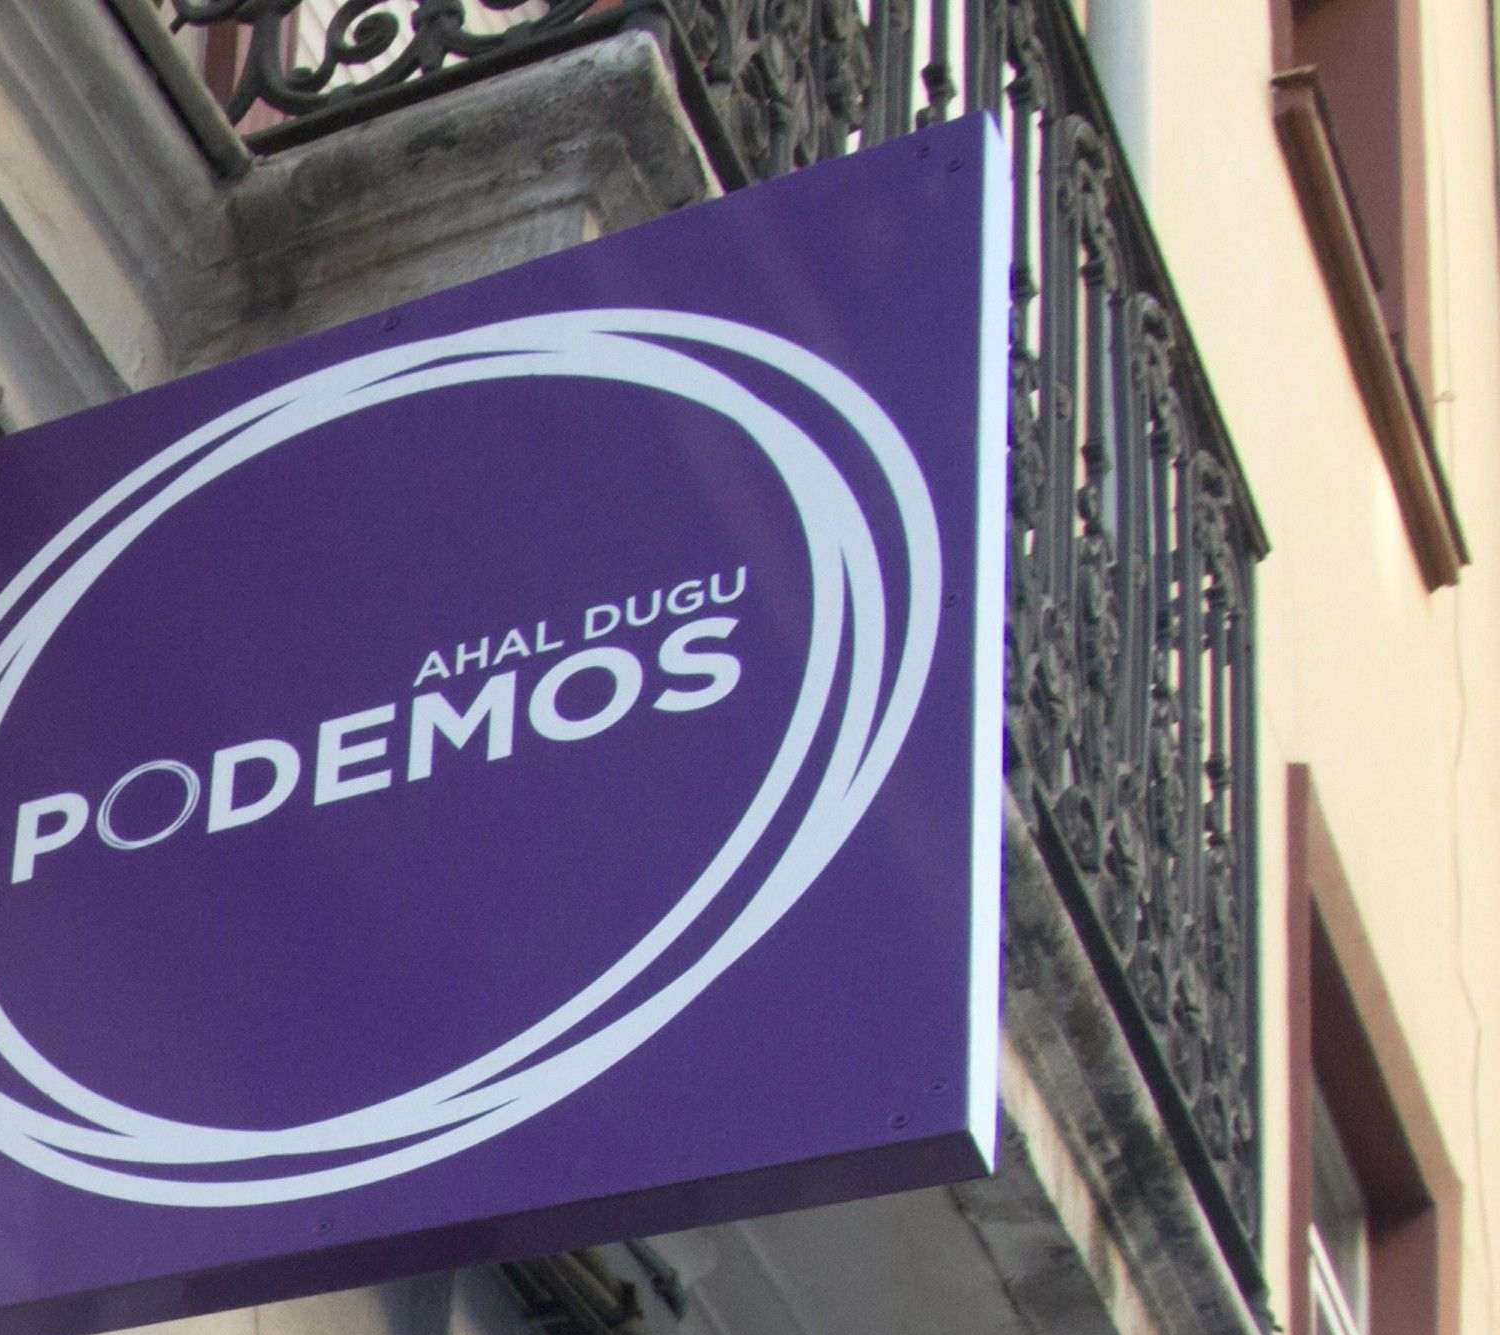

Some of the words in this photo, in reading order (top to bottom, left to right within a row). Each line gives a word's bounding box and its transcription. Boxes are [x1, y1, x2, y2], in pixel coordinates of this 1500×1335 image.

[413, 620, 565, 687] AHAL
[583, 566, 748, 641] DUGU
[11, 616, 742, 884] PODEMOS
